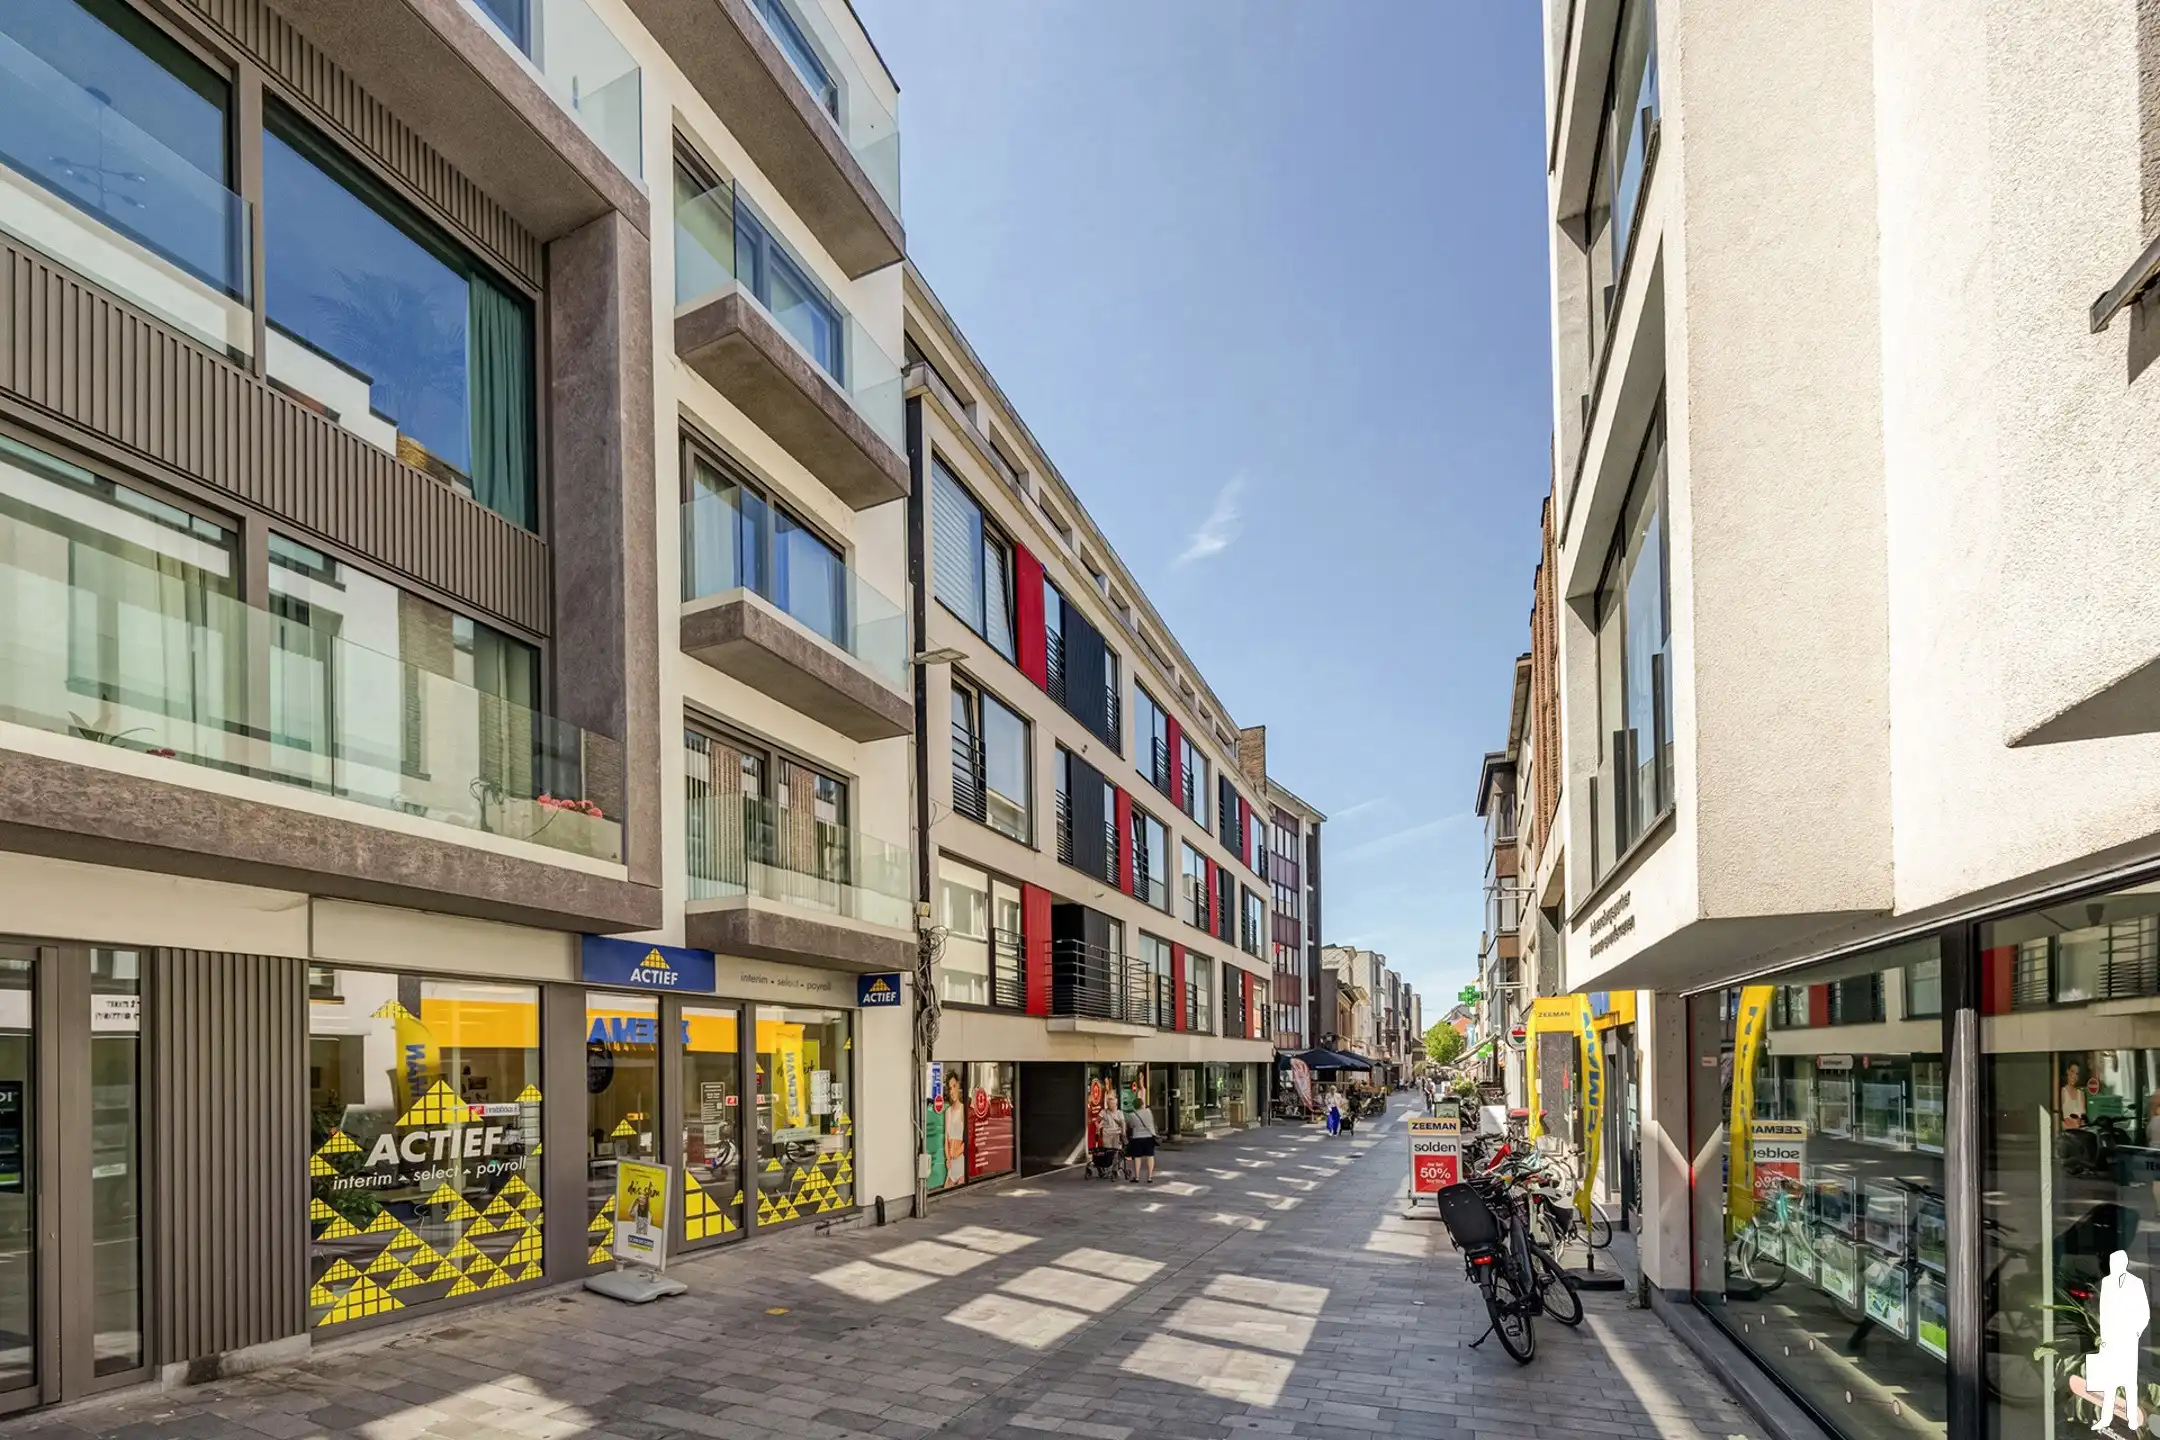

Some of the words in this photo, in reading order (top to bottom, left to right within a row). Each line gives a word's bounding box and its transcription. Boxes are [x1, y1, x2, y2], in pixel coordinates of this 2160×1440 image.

[629, 967, 679, 986] ACTIEF
[740, 971, 769, 985] interim
[777, 976, 799, 989] select
[806, 980, 832, 993] payroll
[862, 991, 897, 1004] ACTIEF
[1538, 1010, 1571, 1018] ZEEMAN
[1412, 1122, 1457, 1131] ZEEMAN
[364, 1126, 504, 1167] ACTIEF
[1414, 1141, 1457, 1153] solden
[333, 1172, 393, 1191] interim
[413, 1165, 459, 1182] select
[476, 1155, 527, 1179] payroll
[1420, 1167, 1451, 1179] 50%
